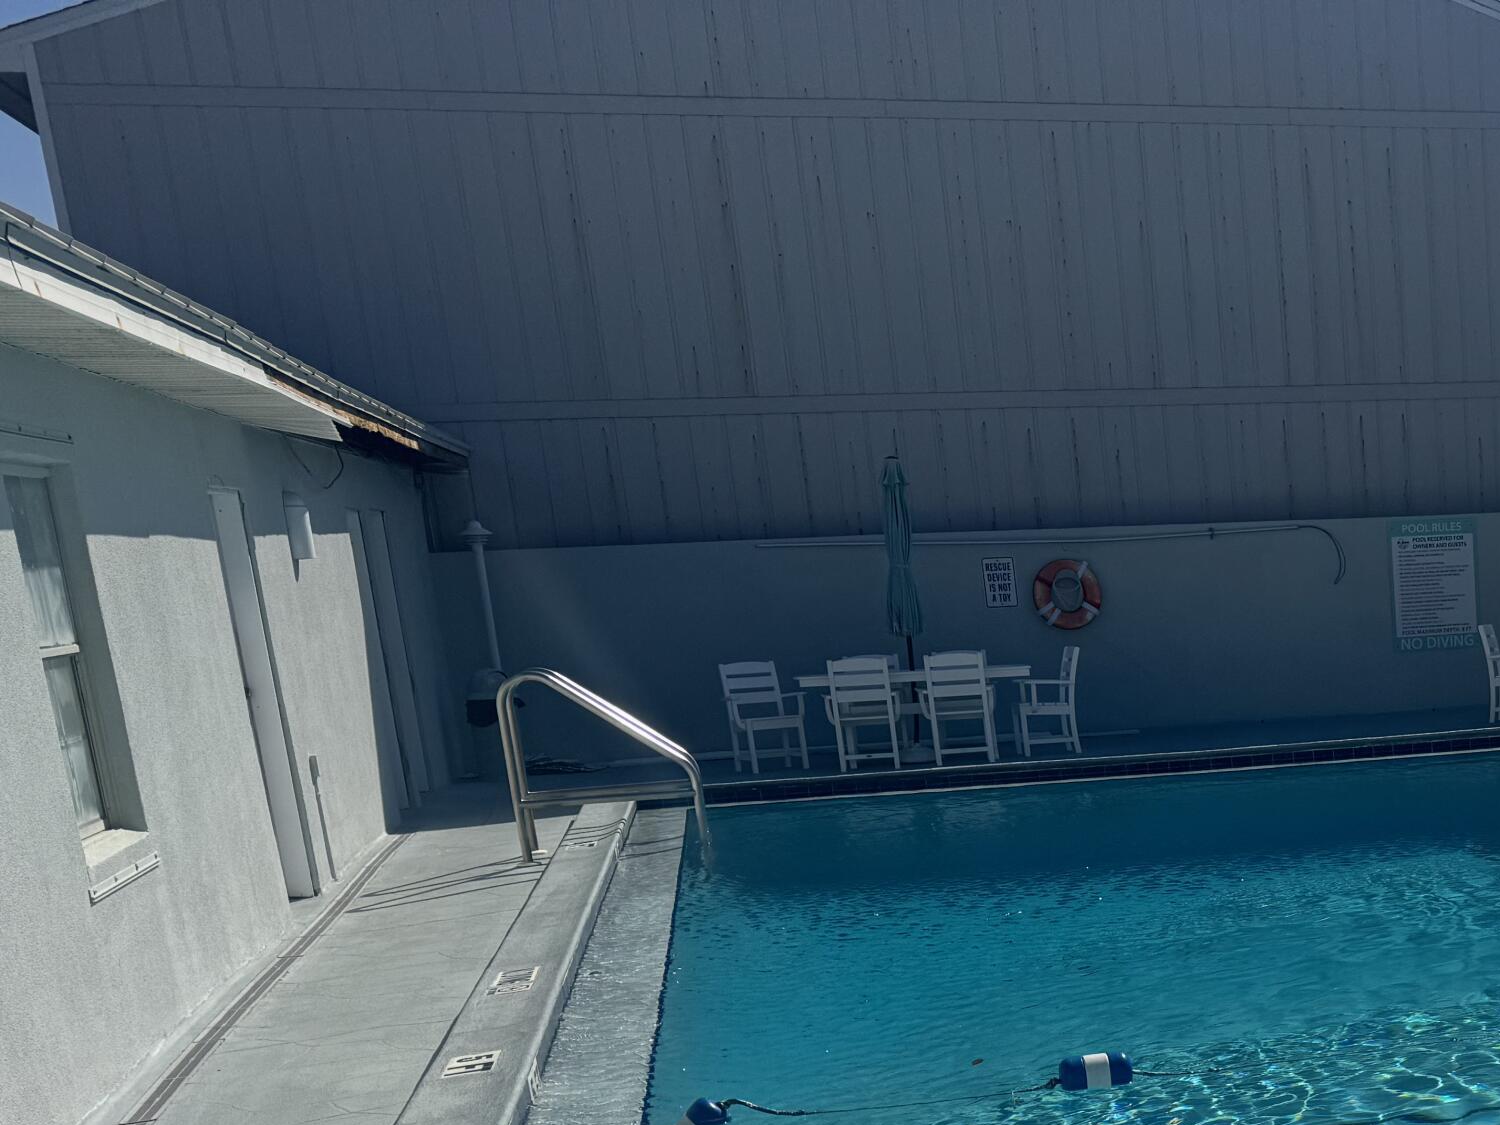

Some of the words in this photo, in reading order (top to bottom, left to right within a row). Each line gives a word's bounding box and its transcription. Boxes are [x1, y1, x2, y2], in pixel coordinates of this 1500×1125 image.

[1401, 523, 1429, 533] POOL
[1432, 522, 1462, 532] RULES
[985, 562, 1012, 572] RESCUE
[987, 572, 1012, 582] DEVICE
[989, 583, 997, 593] IS
[998, 583, 1012, 592] NOT
[992, 594, 998, 602] A
[999, 593, 1012, 602] TOY
[1401, 638, 1422, 650] NO
[1427, 635, 1474, 648] DIVING
[456, 1053, 494, 1063] 5
[443, 1061, 495, 1077] FT
